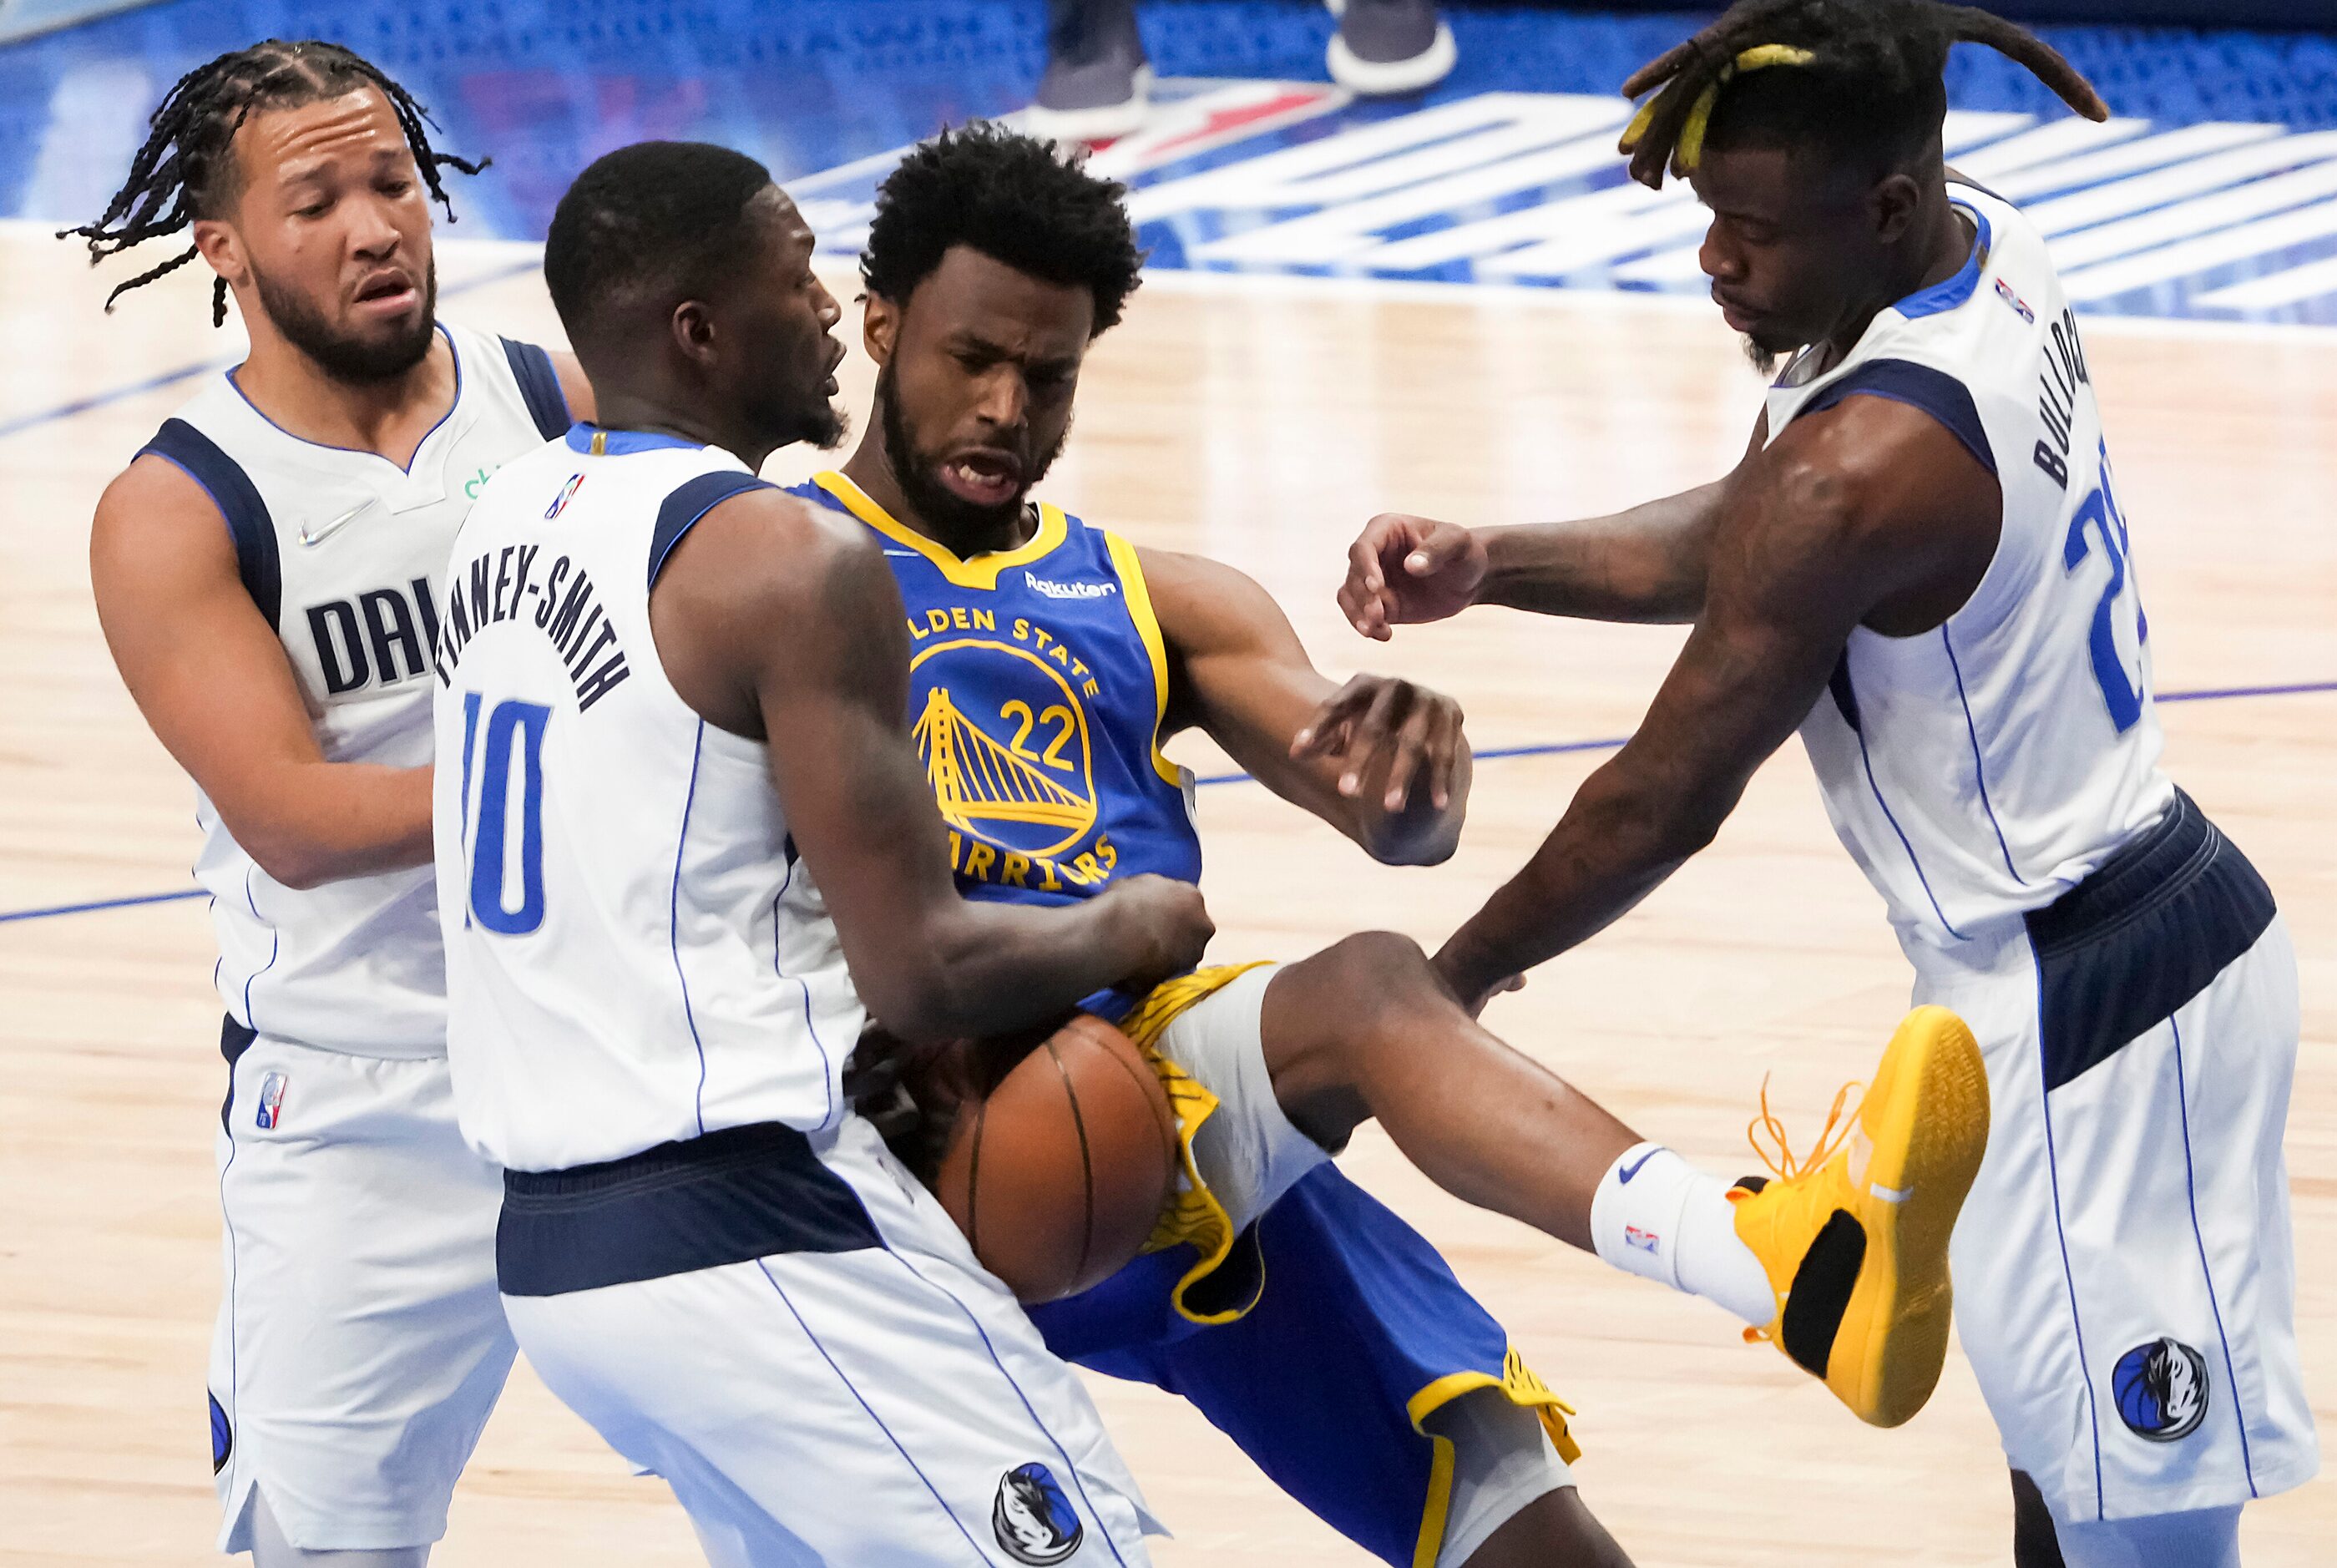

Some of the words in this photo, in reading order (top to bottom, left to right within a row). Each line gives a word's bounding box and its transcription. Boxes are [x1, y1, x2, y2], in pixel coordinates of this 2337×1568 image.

[1012, 618, 1100, 700] STATE
[999, 699, 1075, 772] 22
[460, 691, 554, 937] 10
